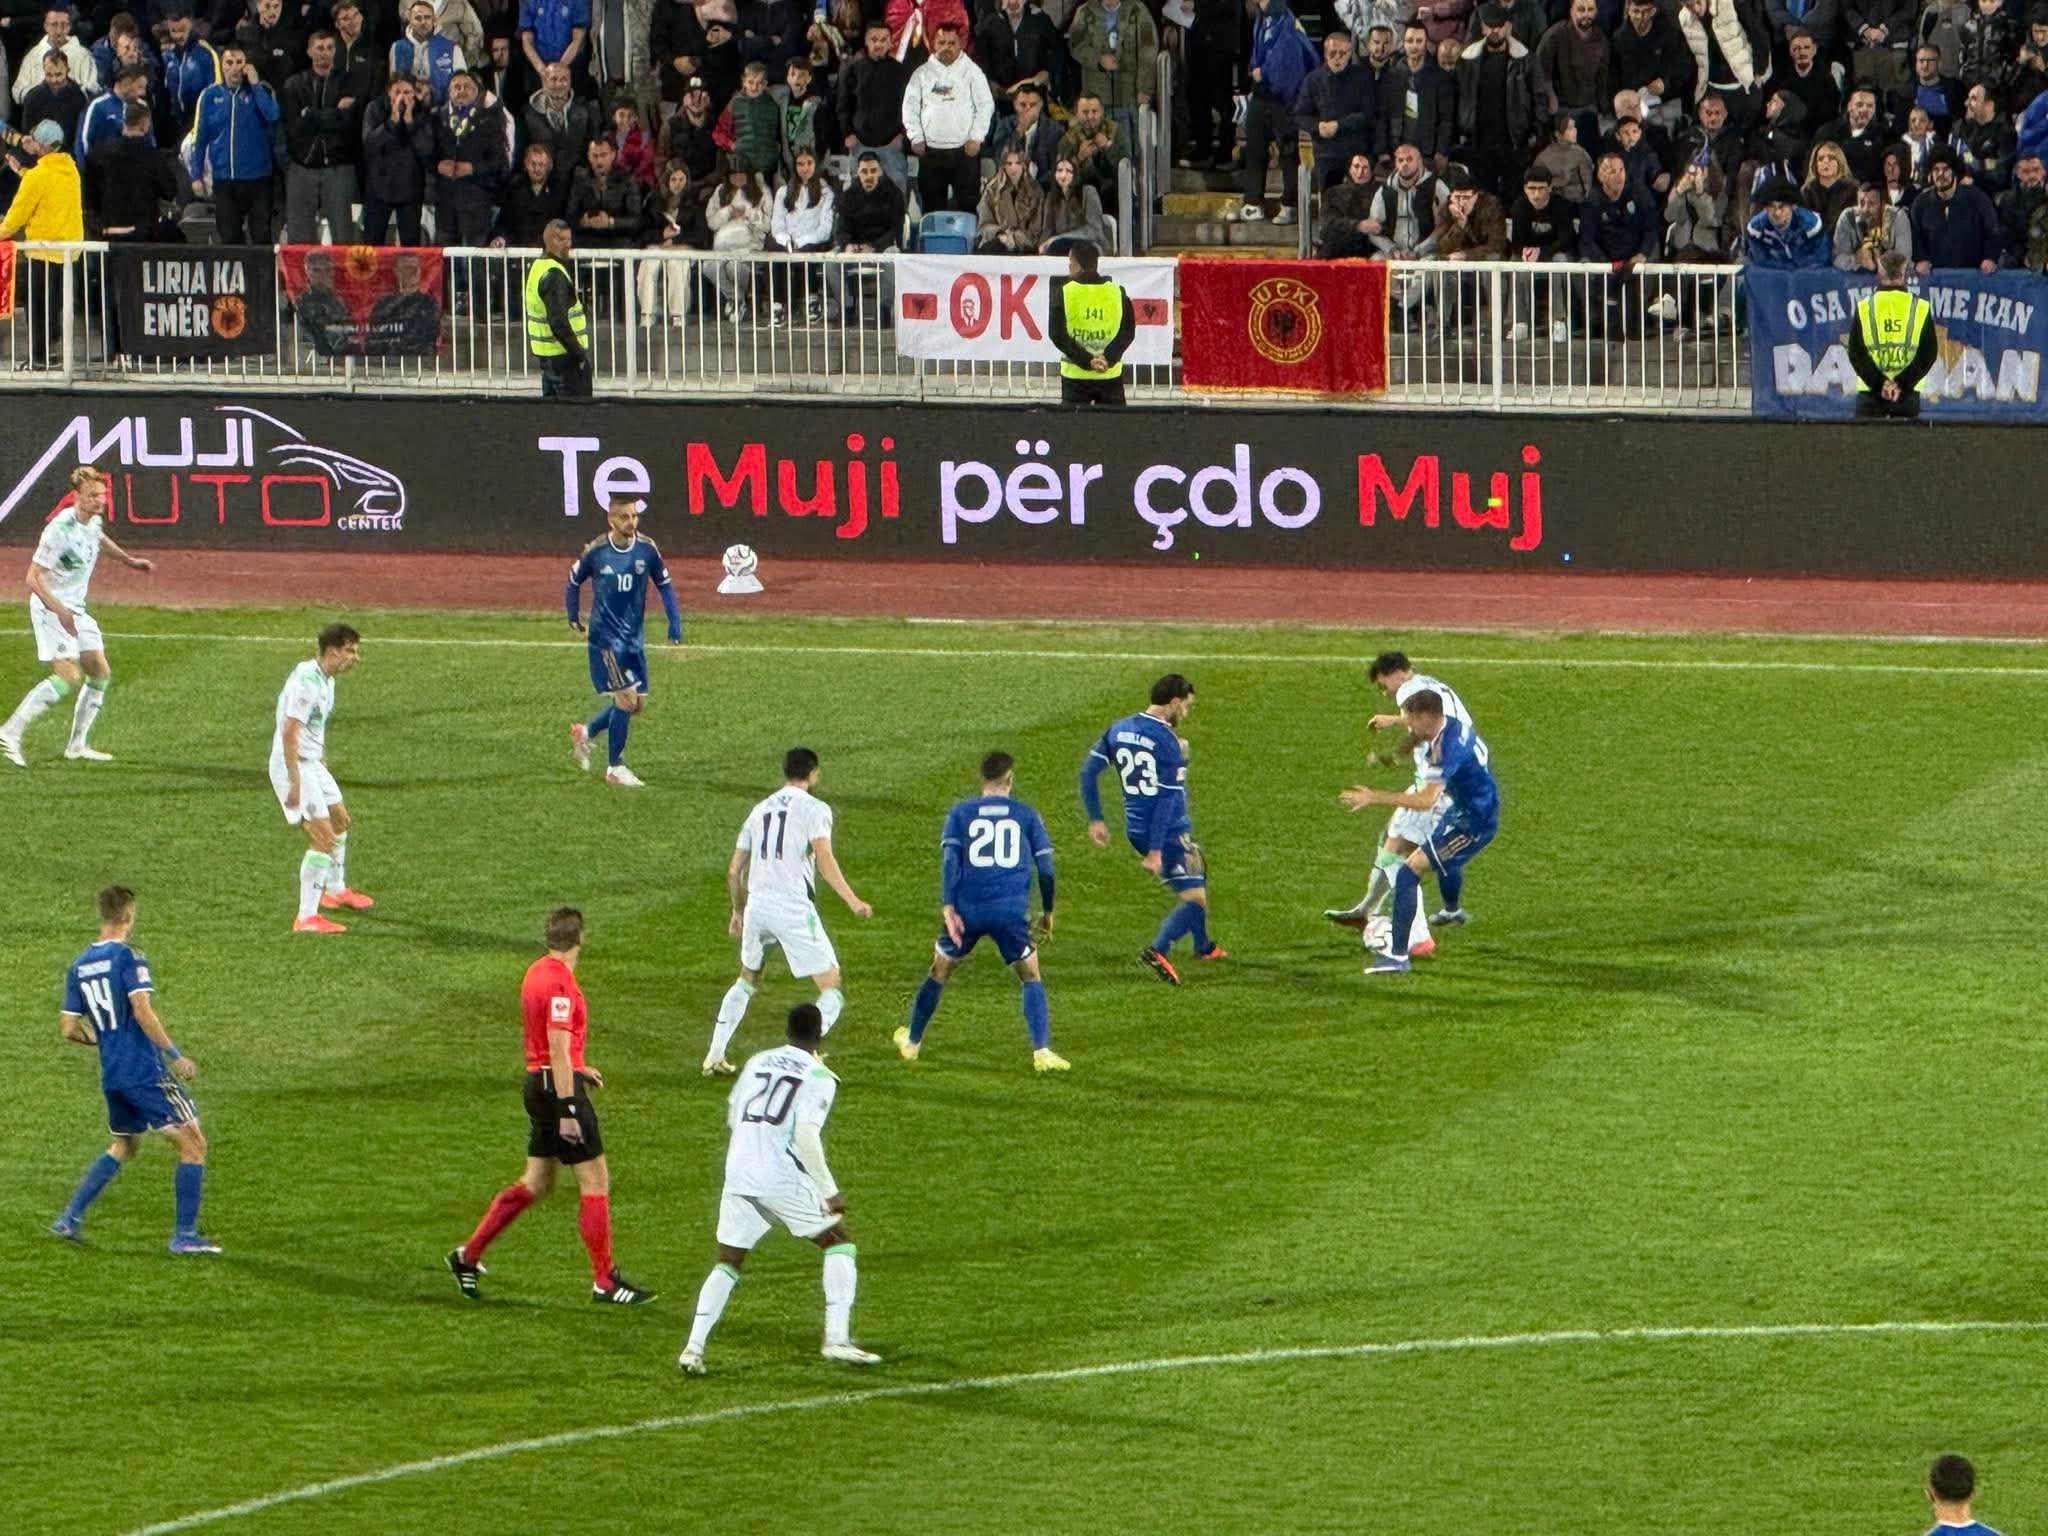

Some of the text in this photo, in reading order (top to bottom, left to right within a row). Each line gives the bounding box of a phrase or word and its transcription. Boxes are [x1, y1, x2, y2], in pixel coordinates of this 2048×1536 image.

[143, 260, 246, 295] LIRIA KA
[143, 297, 209, 337] EMËR
[1085, 307, 1104, 321] 141
[1787, 299, 1807, 329] O
[1811, 289, 1846, 324] SA
[1928, 286, 1969, 321] ME
[1974, 292, 2034, 335] KAN
[1773, 343, 2041, 402] DAAN
[0, 416, 254, 521] MUJI
[538, 433, 1543, 551] Te Muji për çdo Muj
[337, 516, 403, 531] CENTER
[617, 573, 633, 592] 10
[1116, 747, 1158, 796] 23
[761, 810, 787, 860] 11
[968, 818, 1021, 869] 20
[81, 977, 117, 1031] 14
[742, 1072, 803, 1126] 20
